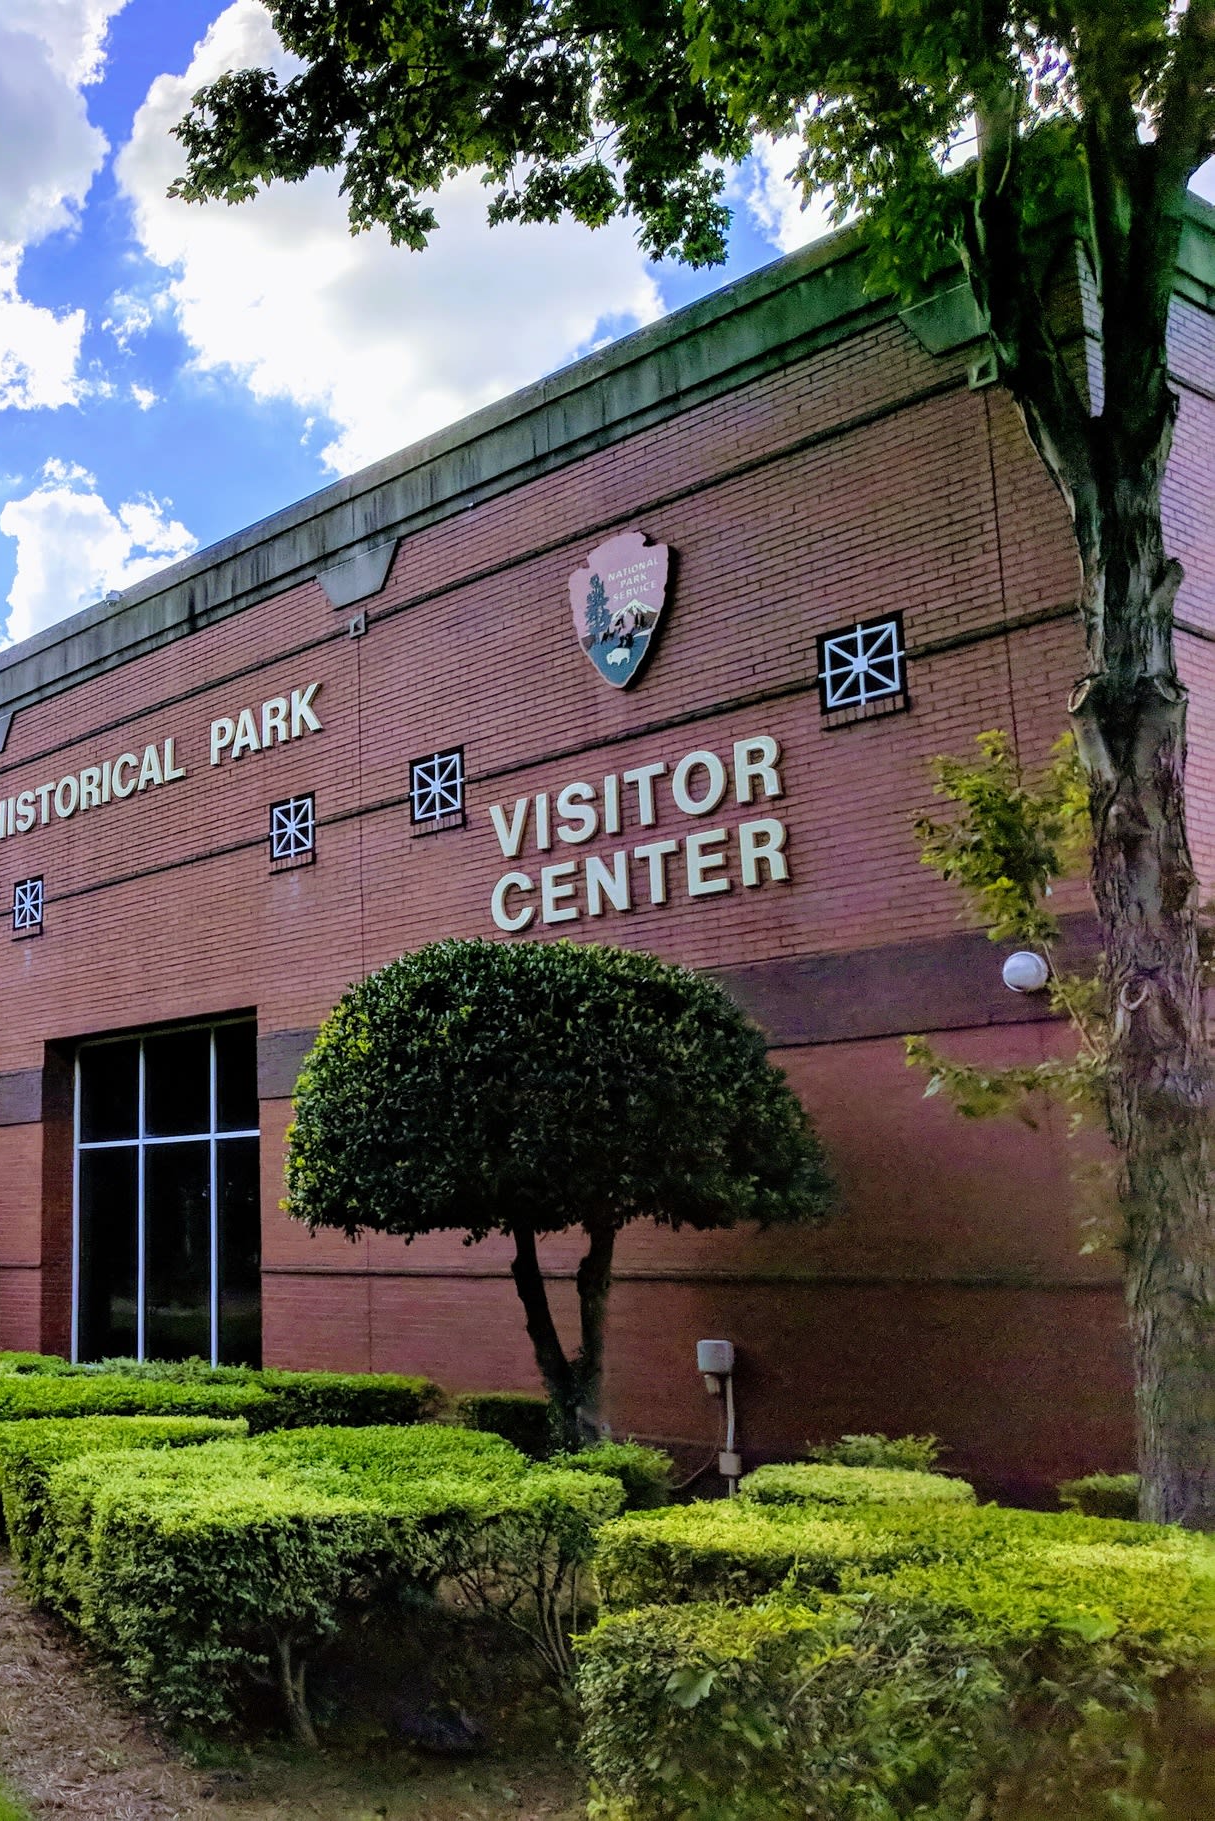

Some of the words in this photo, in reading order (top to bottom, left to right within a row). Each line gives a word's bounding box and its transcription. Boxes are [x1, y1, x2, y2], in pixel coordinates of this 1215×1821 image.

[608, 557, 659, 581] NATIONAL
[613, 580, 658, 601] SERVICE
[620, 572, 648, 589] PARK
[210, 682, 324, 767] PARK
[489, 735, 784, 858] VISITOR
[491, 818, 789, 932] CENTER
